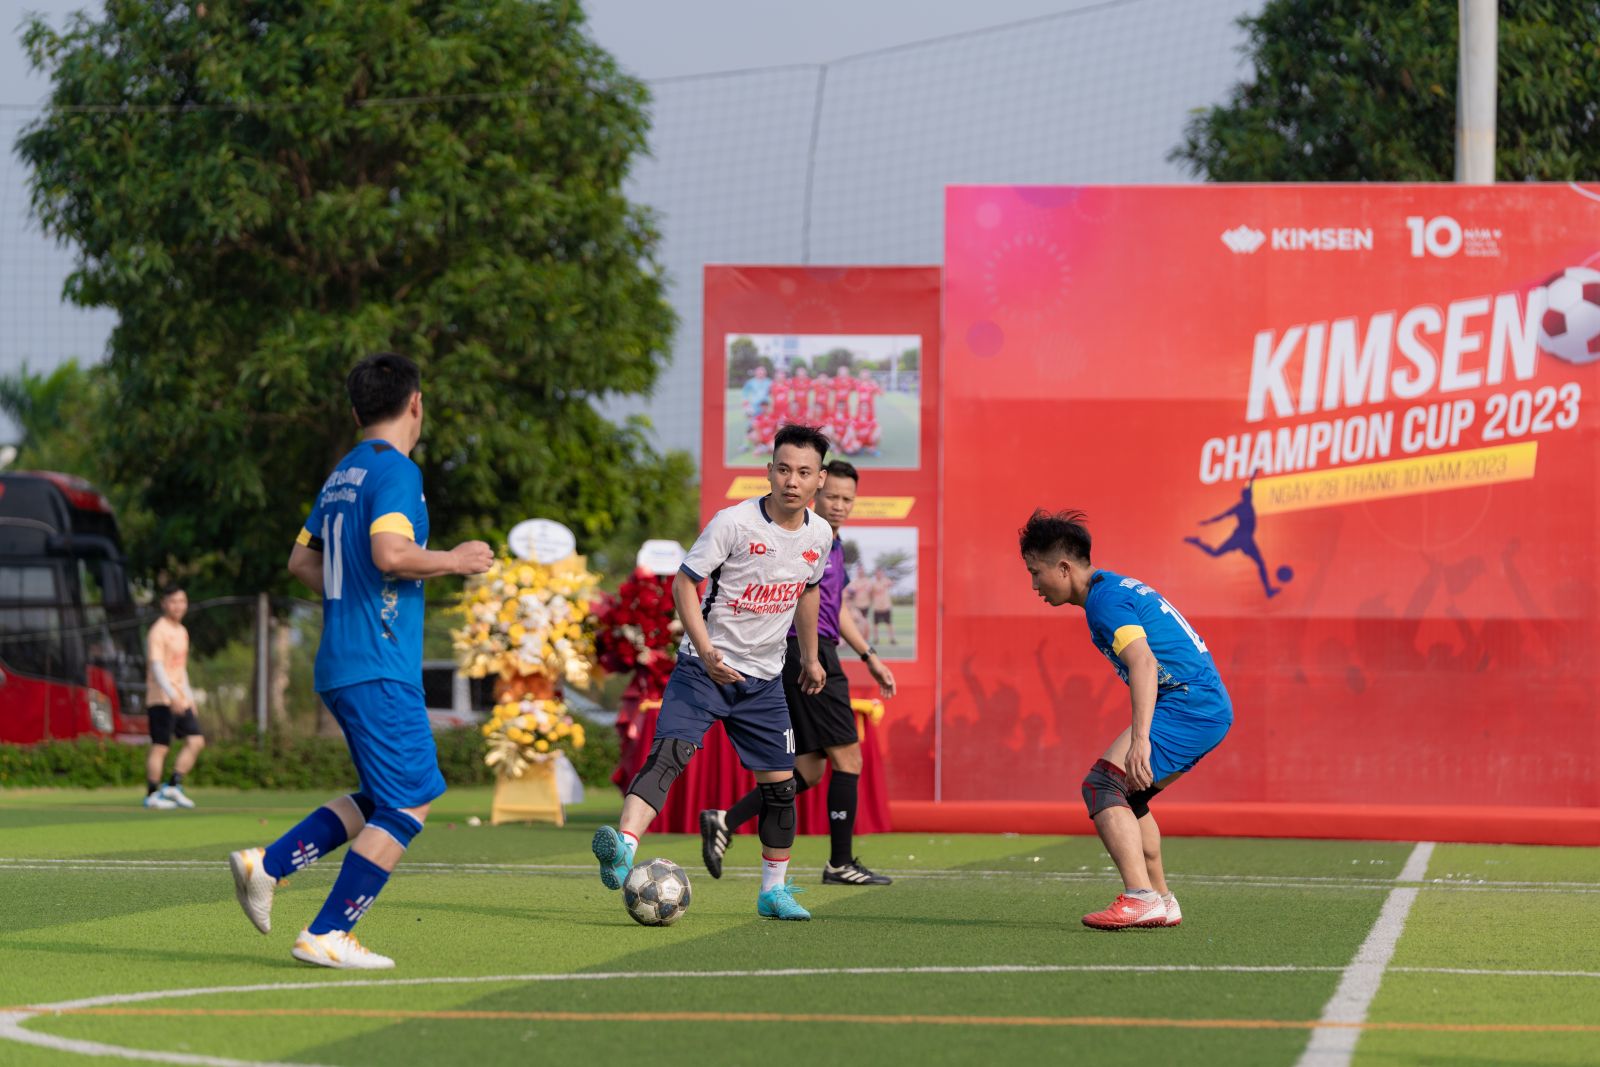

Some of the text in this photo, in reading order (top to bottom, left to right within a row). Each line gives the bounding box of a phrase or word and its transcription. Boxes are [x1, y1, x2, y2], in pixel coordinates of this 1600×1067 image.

[1271, 228, 1373, 250] KIMSEN
[1406, 215, 1463, 258] 10
[1246, 286, 1547, 422] KIMSEN
[1200, 382, 1581, 484] CHAMPION CUP 2023
[1317, 478, 1339, 500] 28
[1403, 465, 1421, 487] 10
[1465, 453, 1508, 479] 2023
[321, 512, 344, 600] 11
[749, 543, 767, 555] 10
[741, 581, 806, 603] KIMSEN
[783, 728, 796, 754] 10
